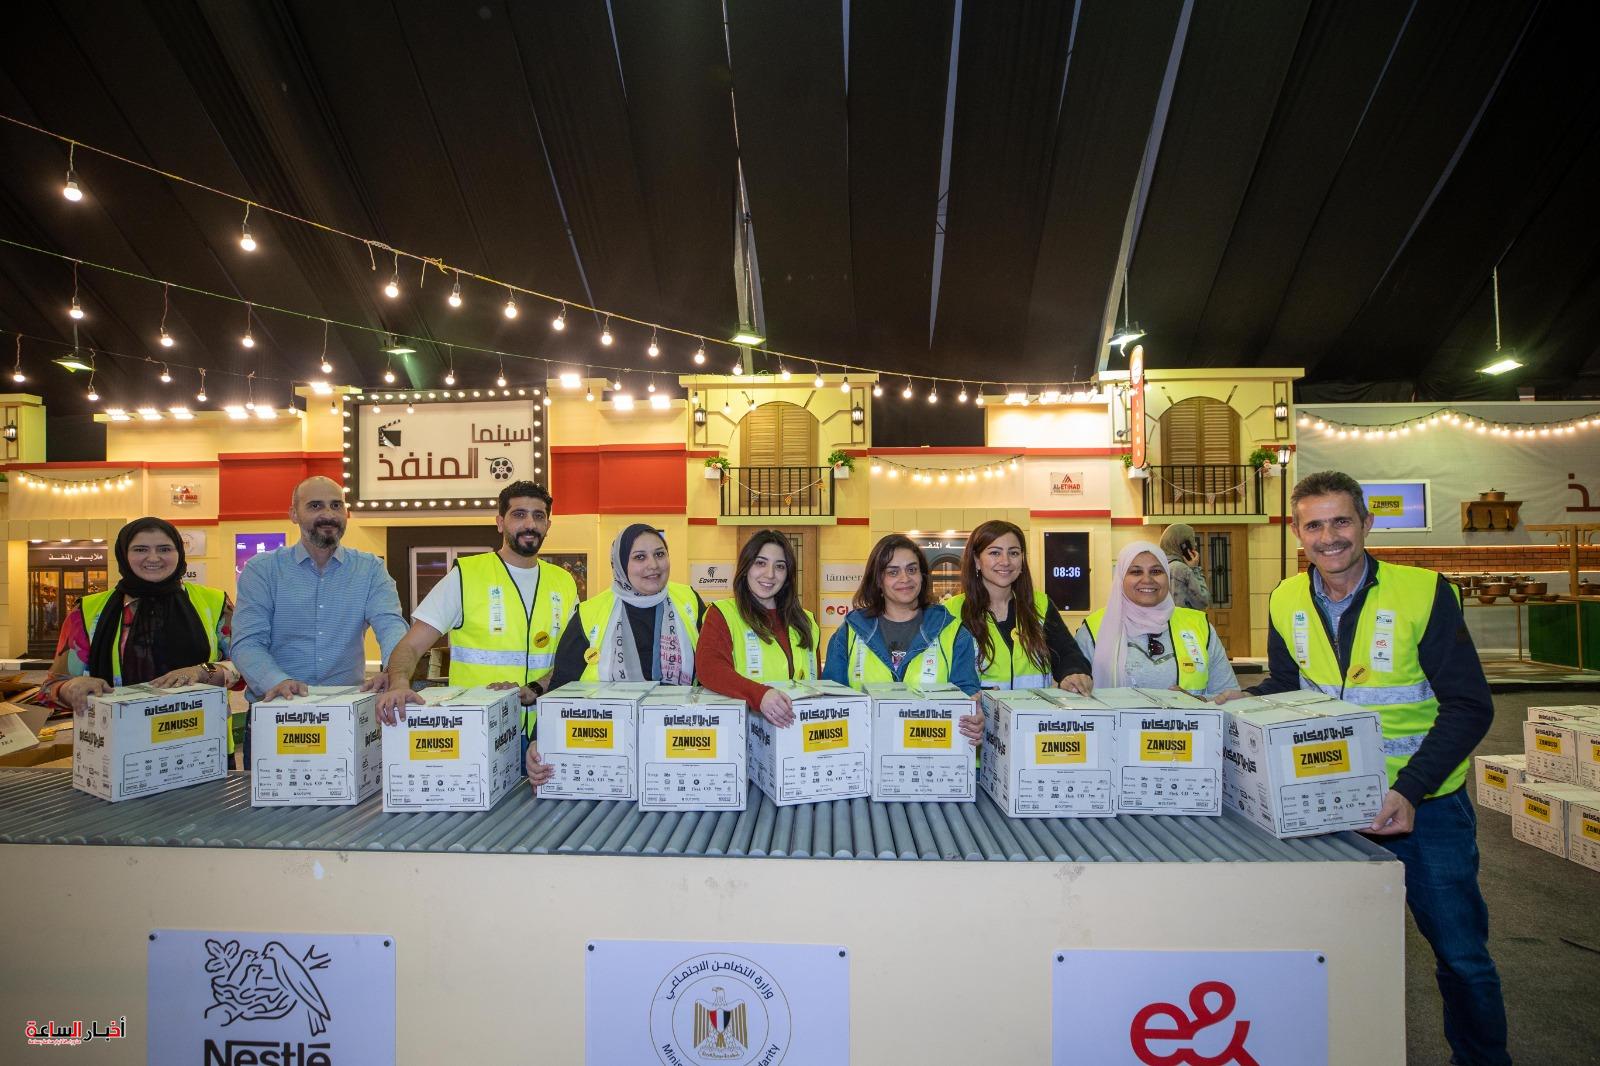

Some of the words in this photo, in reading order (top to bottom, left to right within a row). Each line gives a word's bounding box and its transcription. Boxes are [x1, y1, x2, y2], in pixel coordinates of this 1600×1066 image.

[472, 423, 532, 446] سينما
[377, 448, 478, 480] المنفذ
[1053, 566, 1081, 577] 08:36
[158, 717, 198, 733] ZANUSSI
[282, 733, 321, 744] ZANUSSI
[572, 727, 608, 738] ZANUSSI
[809, 728, 843, 741] ZANUSSI
[910, 727, 946, 738] ZANUSSI
[416, 738, 454, 749] ZANUSSI
[672, 736, 711, 747] ZANUSSI
[1041, 741, 1081, 752] ZANUSSI
[1146, 739, 1186, 751] ZANUSSI
[1300, 749, 1343, 765] ZANUSSI
[711, 960, 756, 979] التضامن
[666, 960, 709, 1000] الاجتماعي
[754, 975, 774, 1000] وزارة
